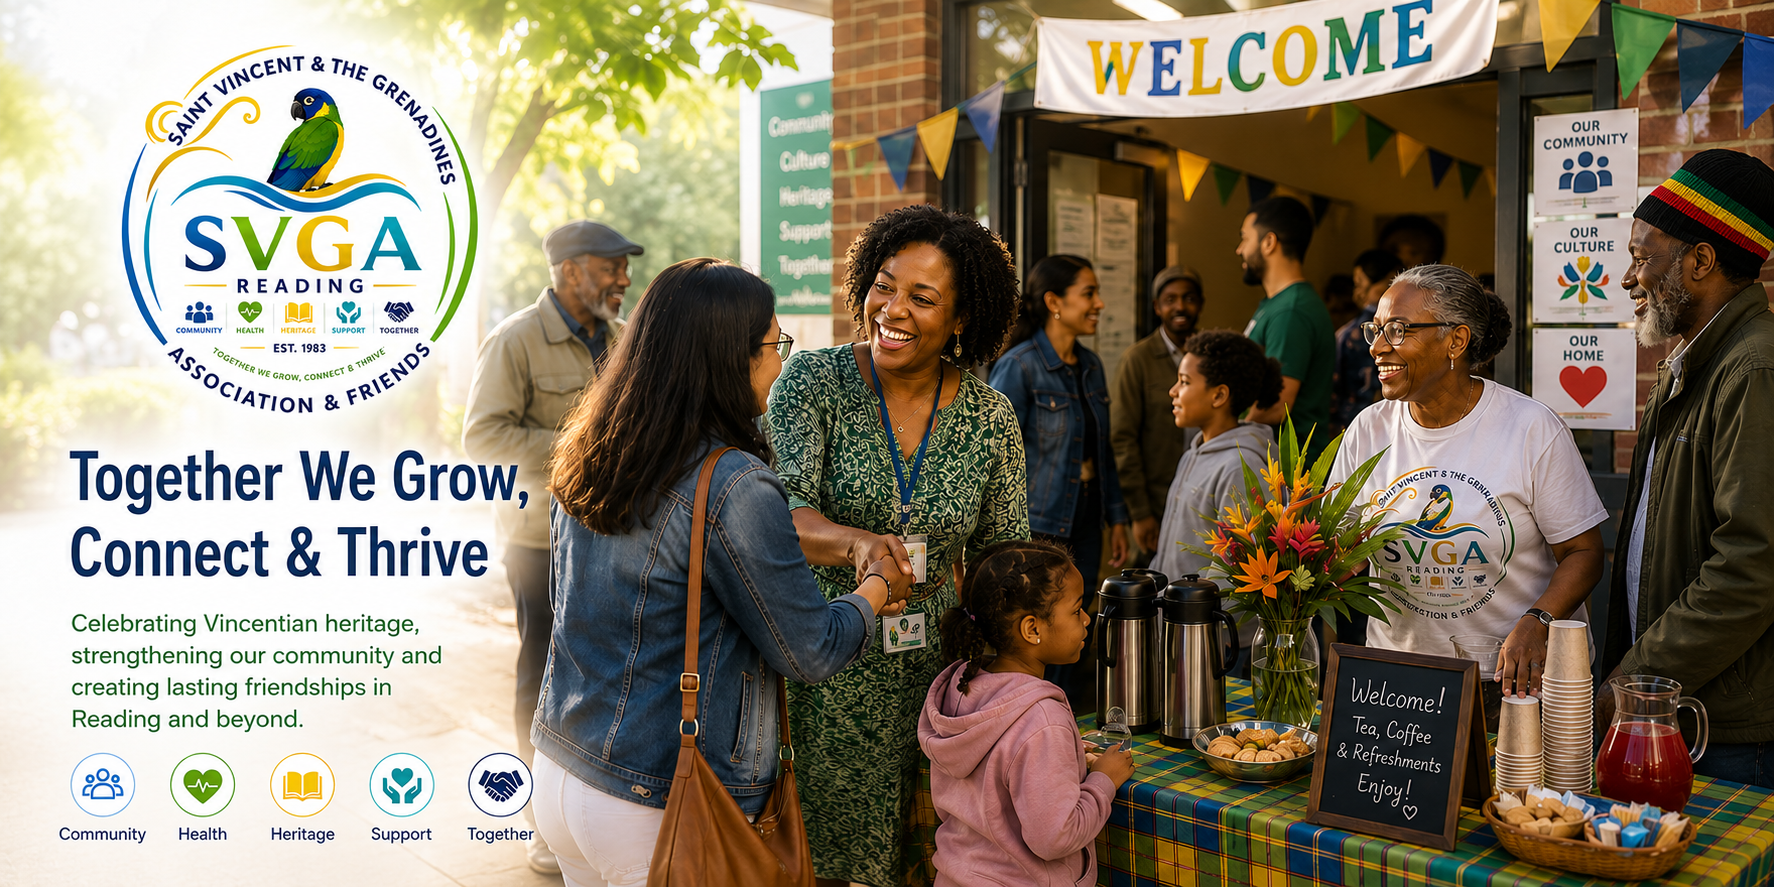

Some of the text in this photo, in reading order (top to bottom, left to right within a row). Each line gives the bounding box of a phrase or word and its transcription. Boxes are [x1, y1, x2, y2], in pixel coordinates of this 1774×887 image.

[1087, 0, 1434, 96] WELCOME
[1572, 120, 1600, 132] OUR
[1544, 133, 1628, 150] COMMUNITY
[779, 149, 831, 172] Culture
[779, 219, 833, 244] Support
[1570, 228, 1598, 238] OUR
[1554, 240, 1614, 253] CULTURE
[1570, 336, 1598, 346] OUR
[1564, 351, 1604, 361] HOME
[1397, 470, 1438, 488] VINCENT
[1450, 470, 1467, 482] THE
[1383, 540, 1489, 565] SVGA
[1351, 677, 1446, 714] Welcome!
[1353, 716, 1432, 746] Tea, Coffee
[1337, 742, 1441, 774] & Refreshments
[1358, 773, 1412, 807] Enjoy!
